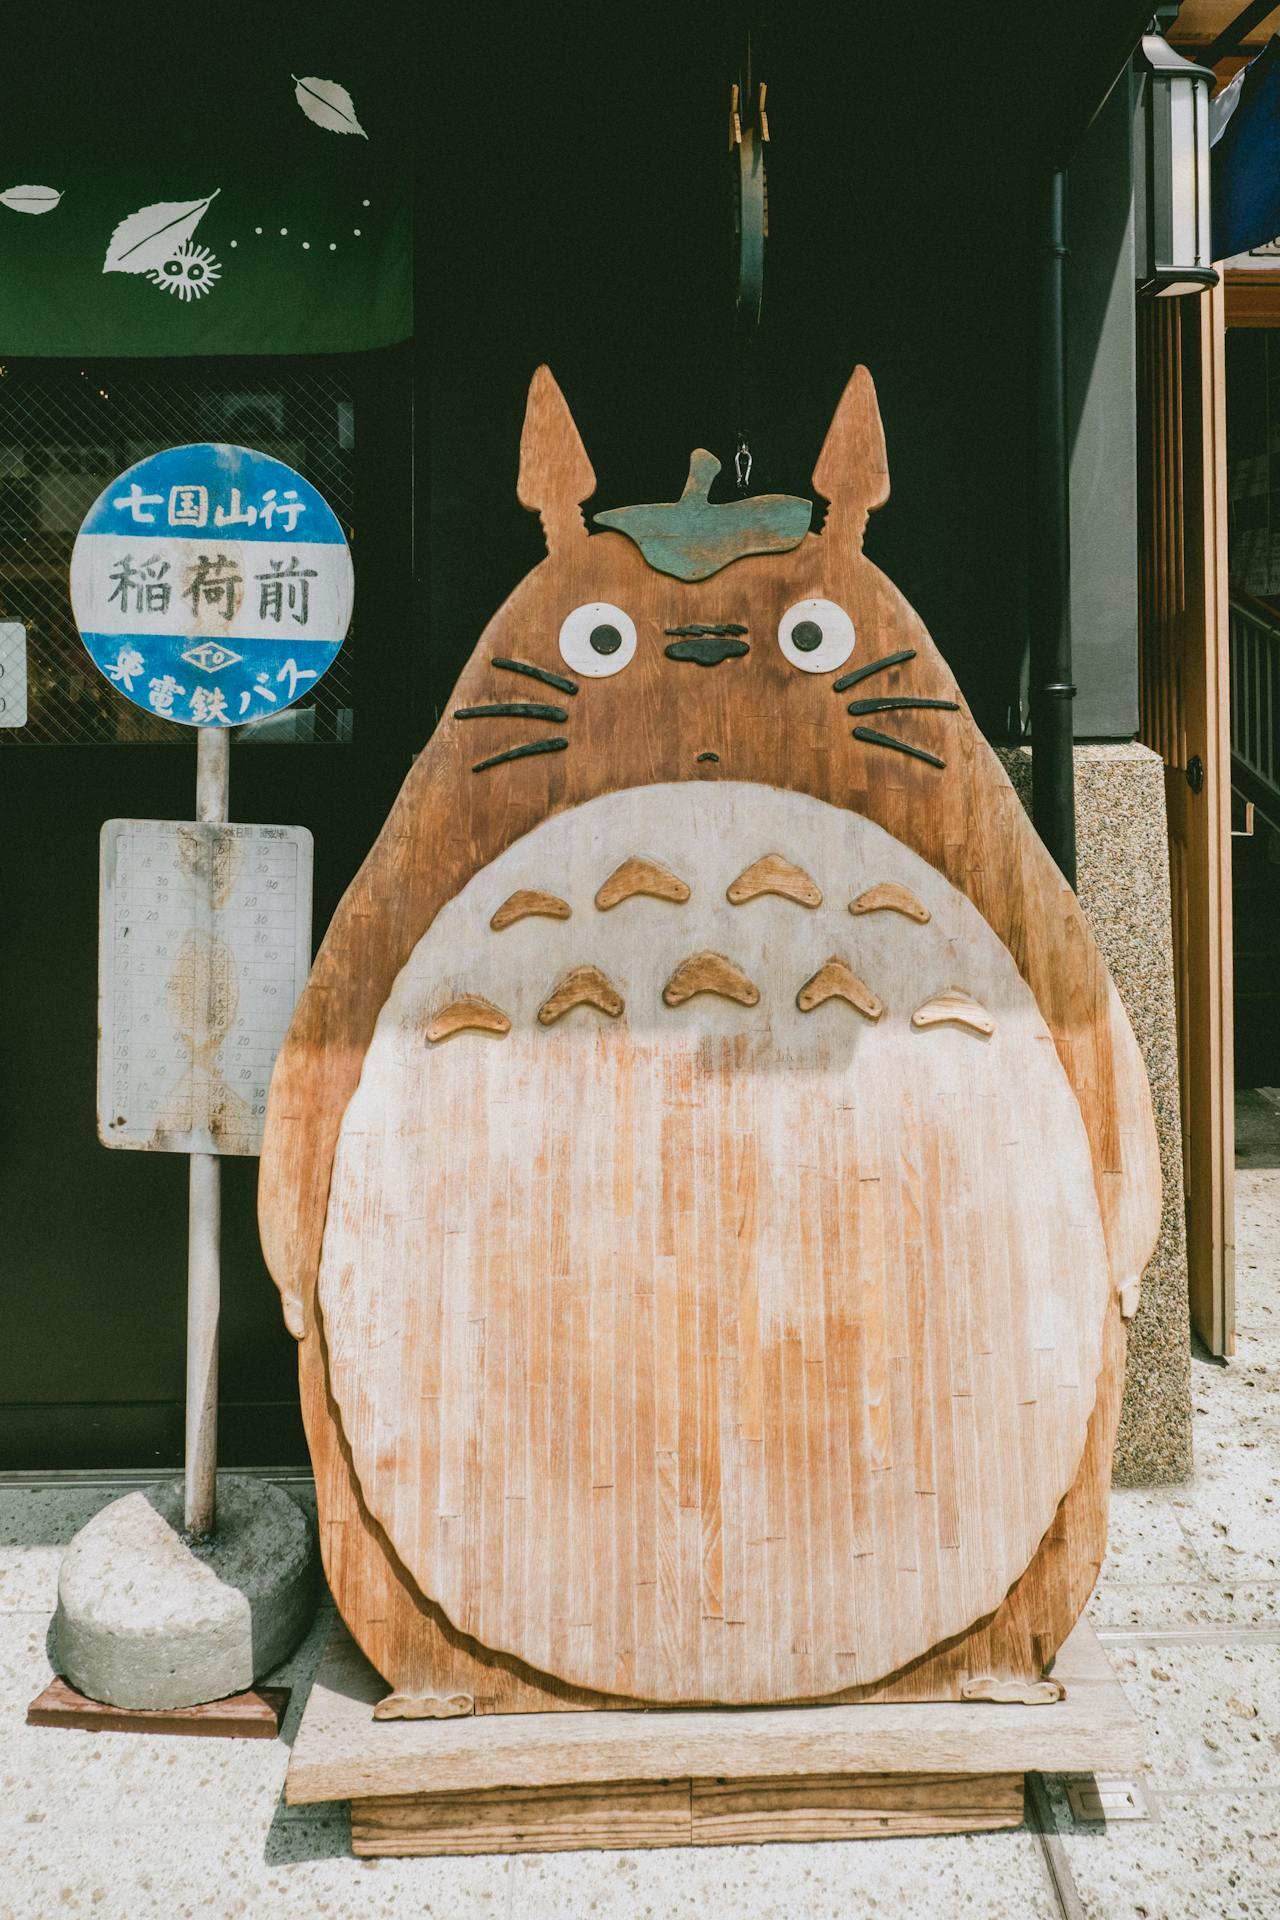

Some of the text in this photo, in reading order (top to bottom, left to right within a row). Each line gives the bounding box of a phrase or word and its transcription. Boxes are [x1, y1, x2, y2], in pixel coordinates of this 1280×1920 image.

[112, 482, 306, 532] 七国山行
[107, 553, 318, 626] 稲荷前
[155, 875, 169, 886] 30
[154, 891, 169, 903] 30
[145, 910, 160, 921] 20
[237, 1035, 250, 1046] 20
[116, 1045, 129, 1057] 18
[116, 1062, 129, 1074] 19
